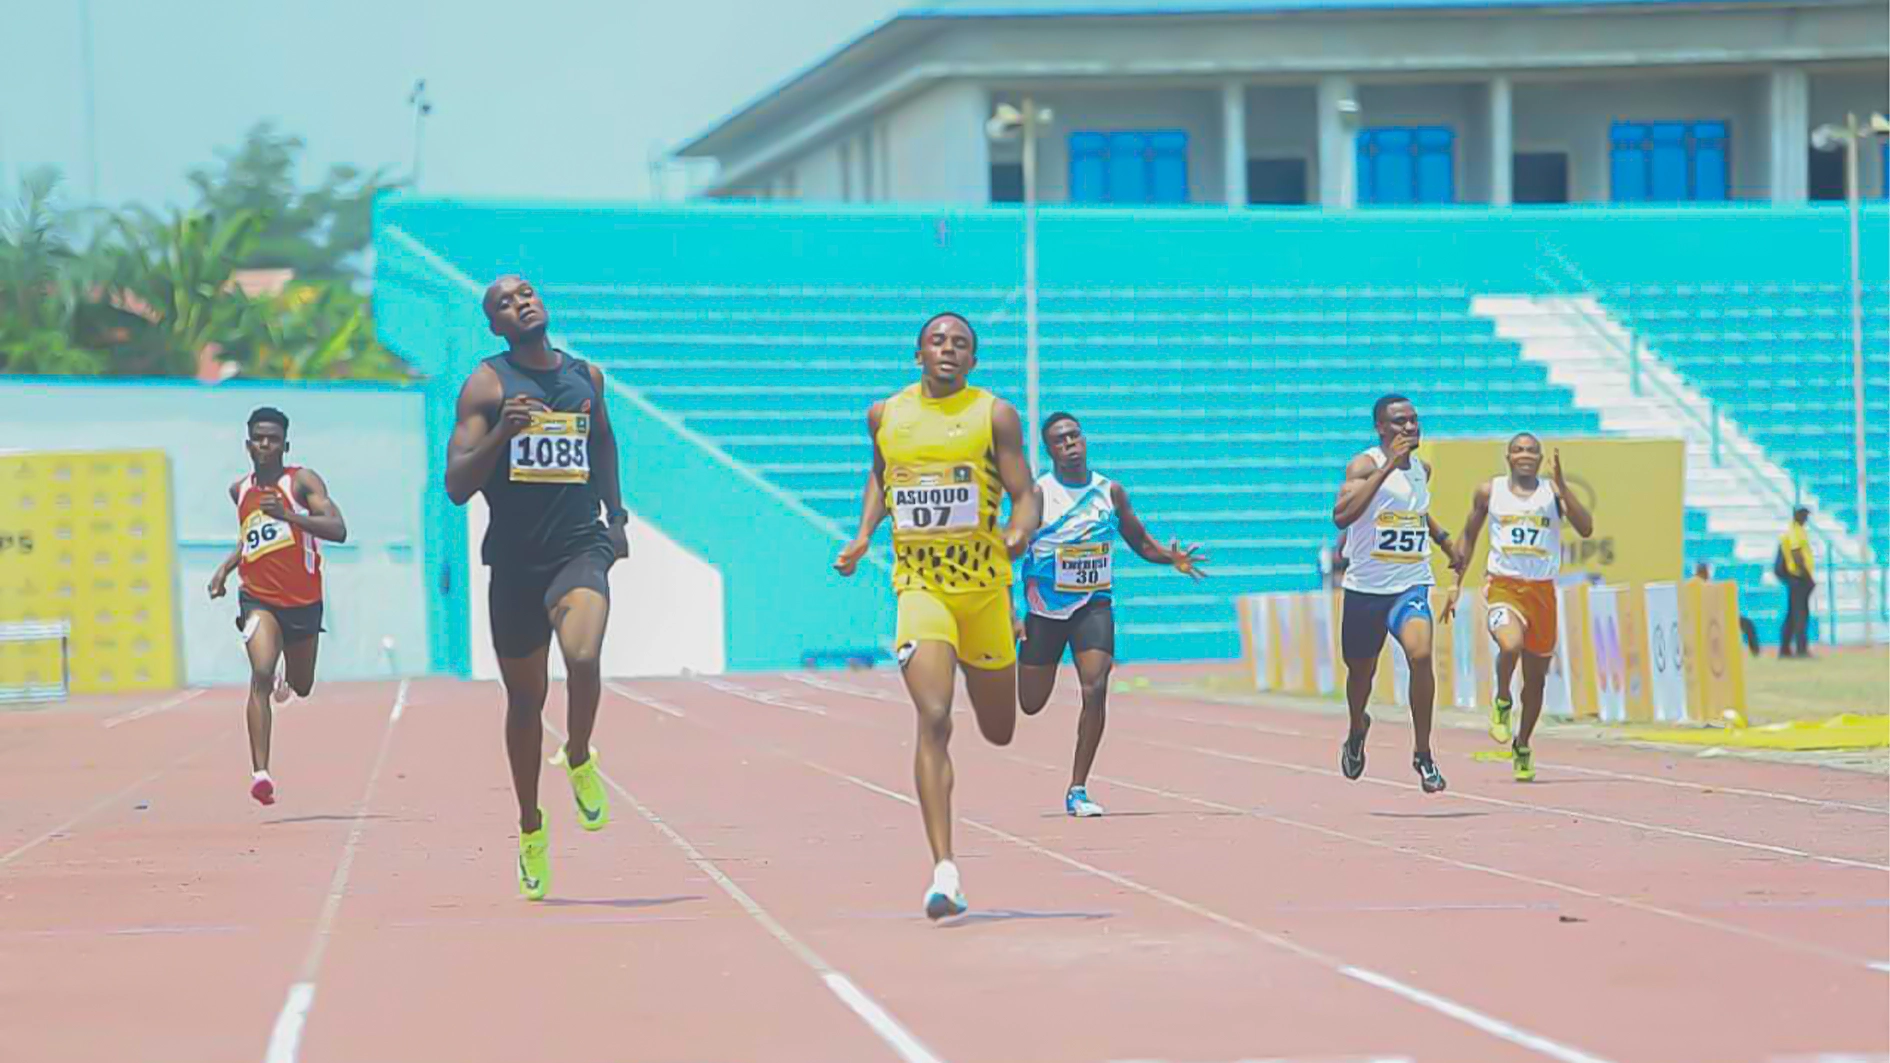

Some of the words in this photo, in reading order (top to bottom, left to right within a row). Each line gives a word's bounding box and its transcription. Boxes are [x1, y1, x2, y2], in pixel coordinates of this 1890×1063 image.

[517, 437, 584, 467] 1085
[896, 487, 969, 506] ASUQUO
[912, 506, 952, 528] 07
[246, 523, 277, 549] 96
[1379, 529, 1426, 552] 257
[1511, 527, 1540, 546] 97
[1076, 570, 1099, 585] 30
